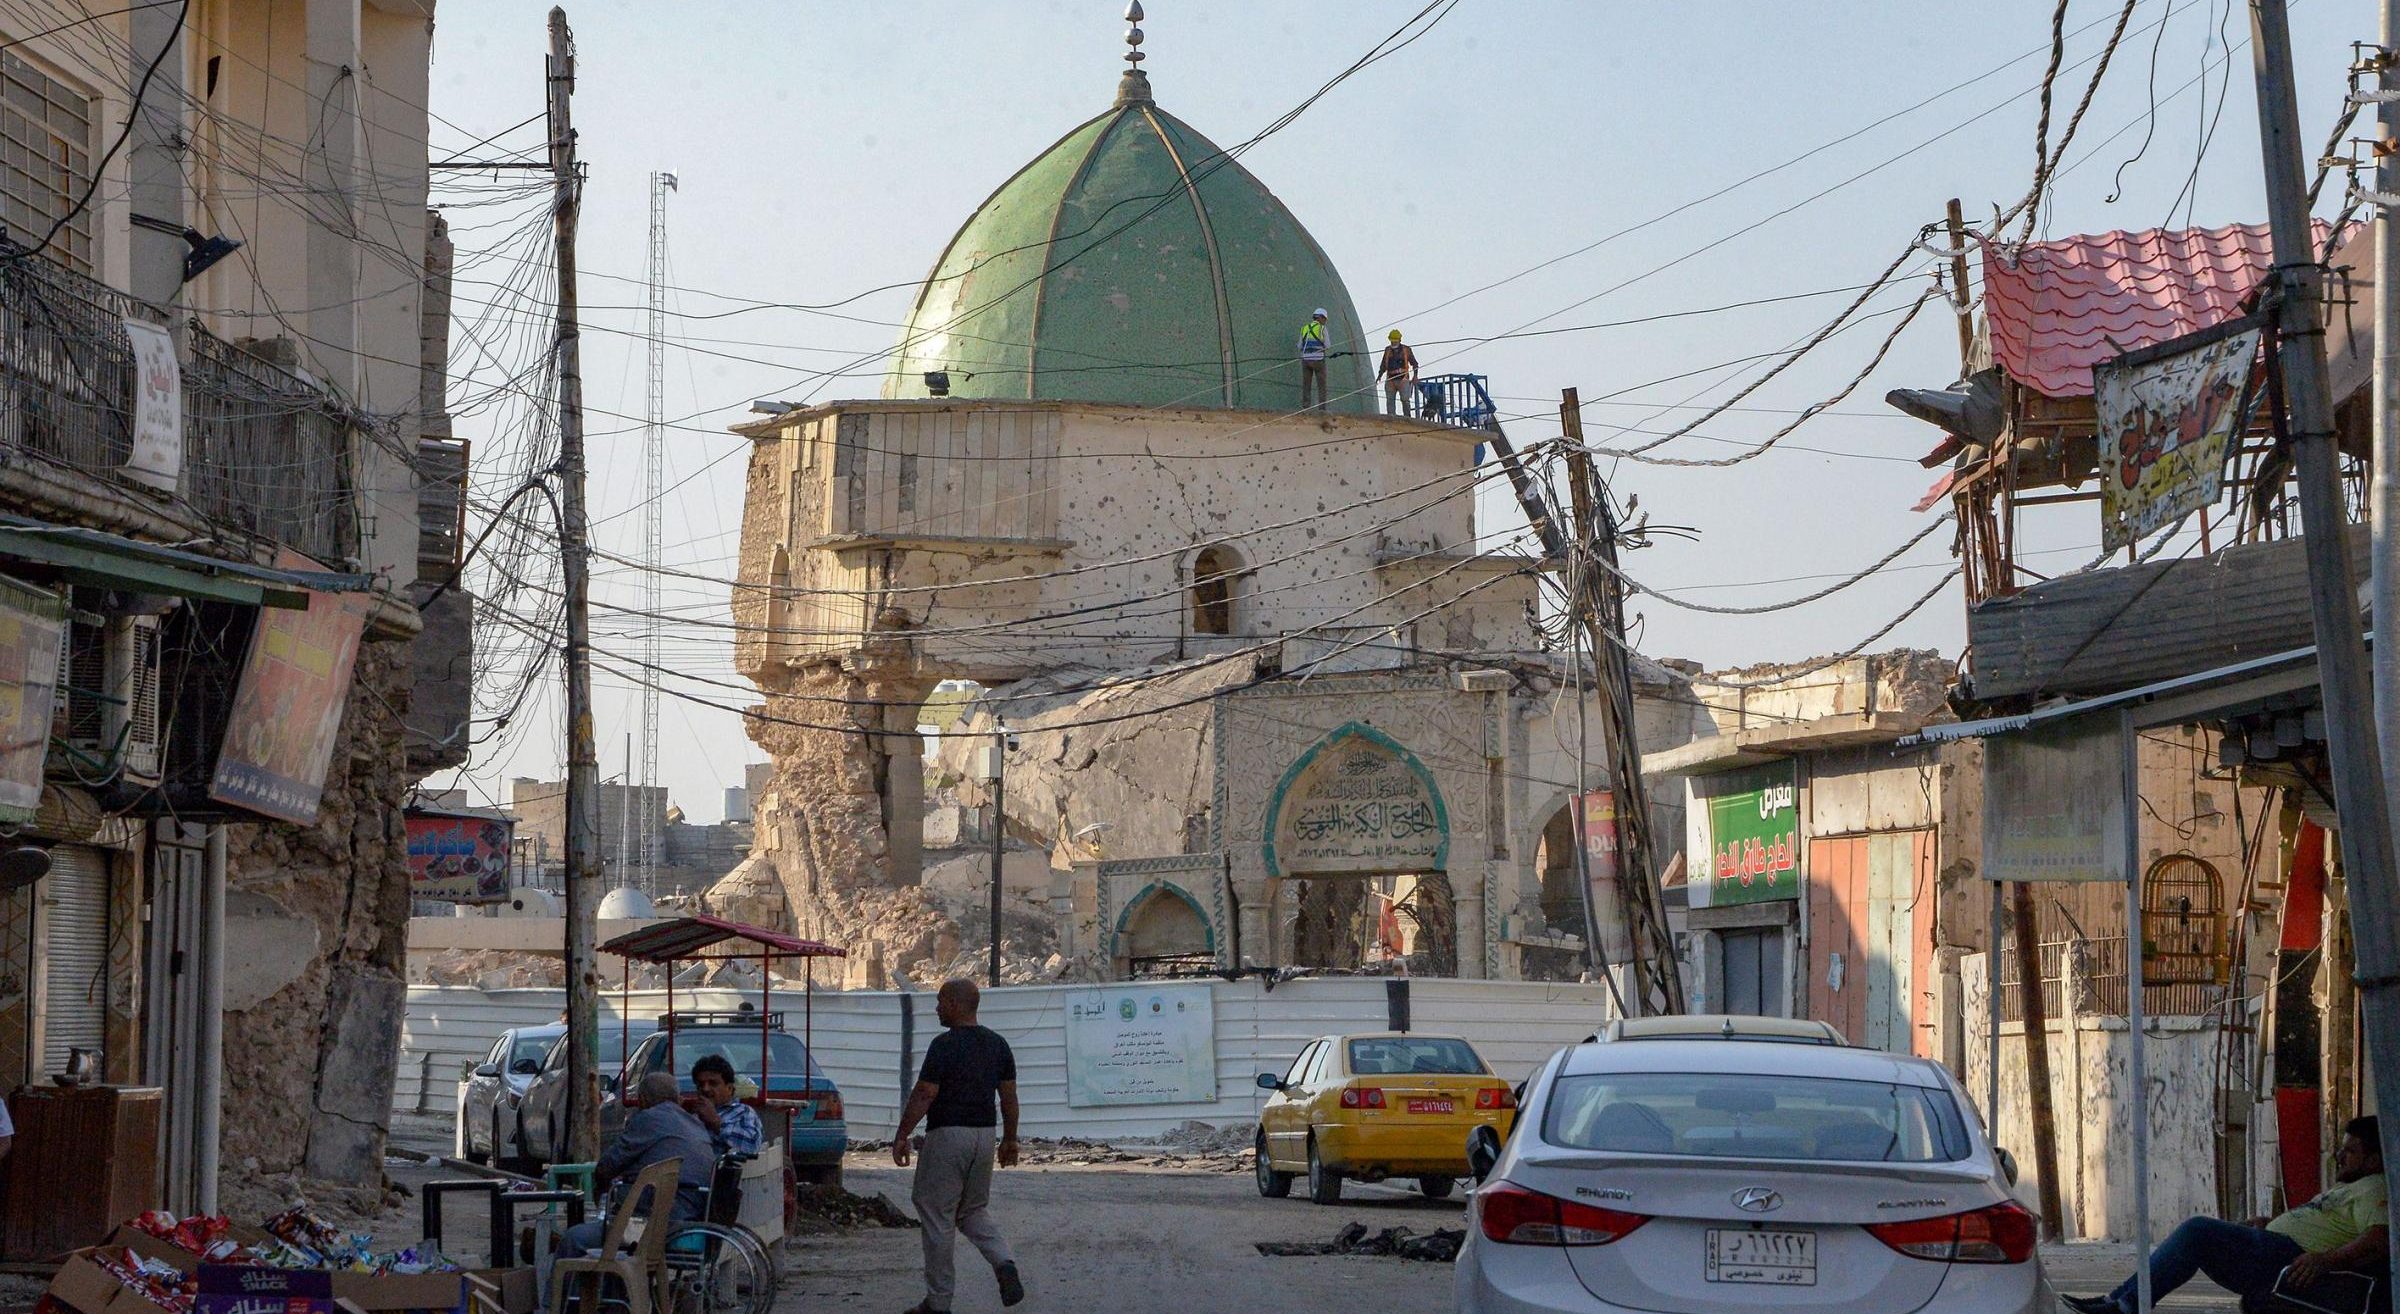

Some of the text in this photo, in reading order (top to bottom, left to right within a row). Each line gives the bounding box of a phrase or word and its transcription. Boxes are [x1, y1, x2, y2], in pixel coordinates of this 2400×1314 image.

[1759, 782, 1792, 820] معرض
[1715, 840, 1739, 890] النجار
[1740, 836, 1766, 888] طارق
[1767, 831, 1795, 888] الحاج
